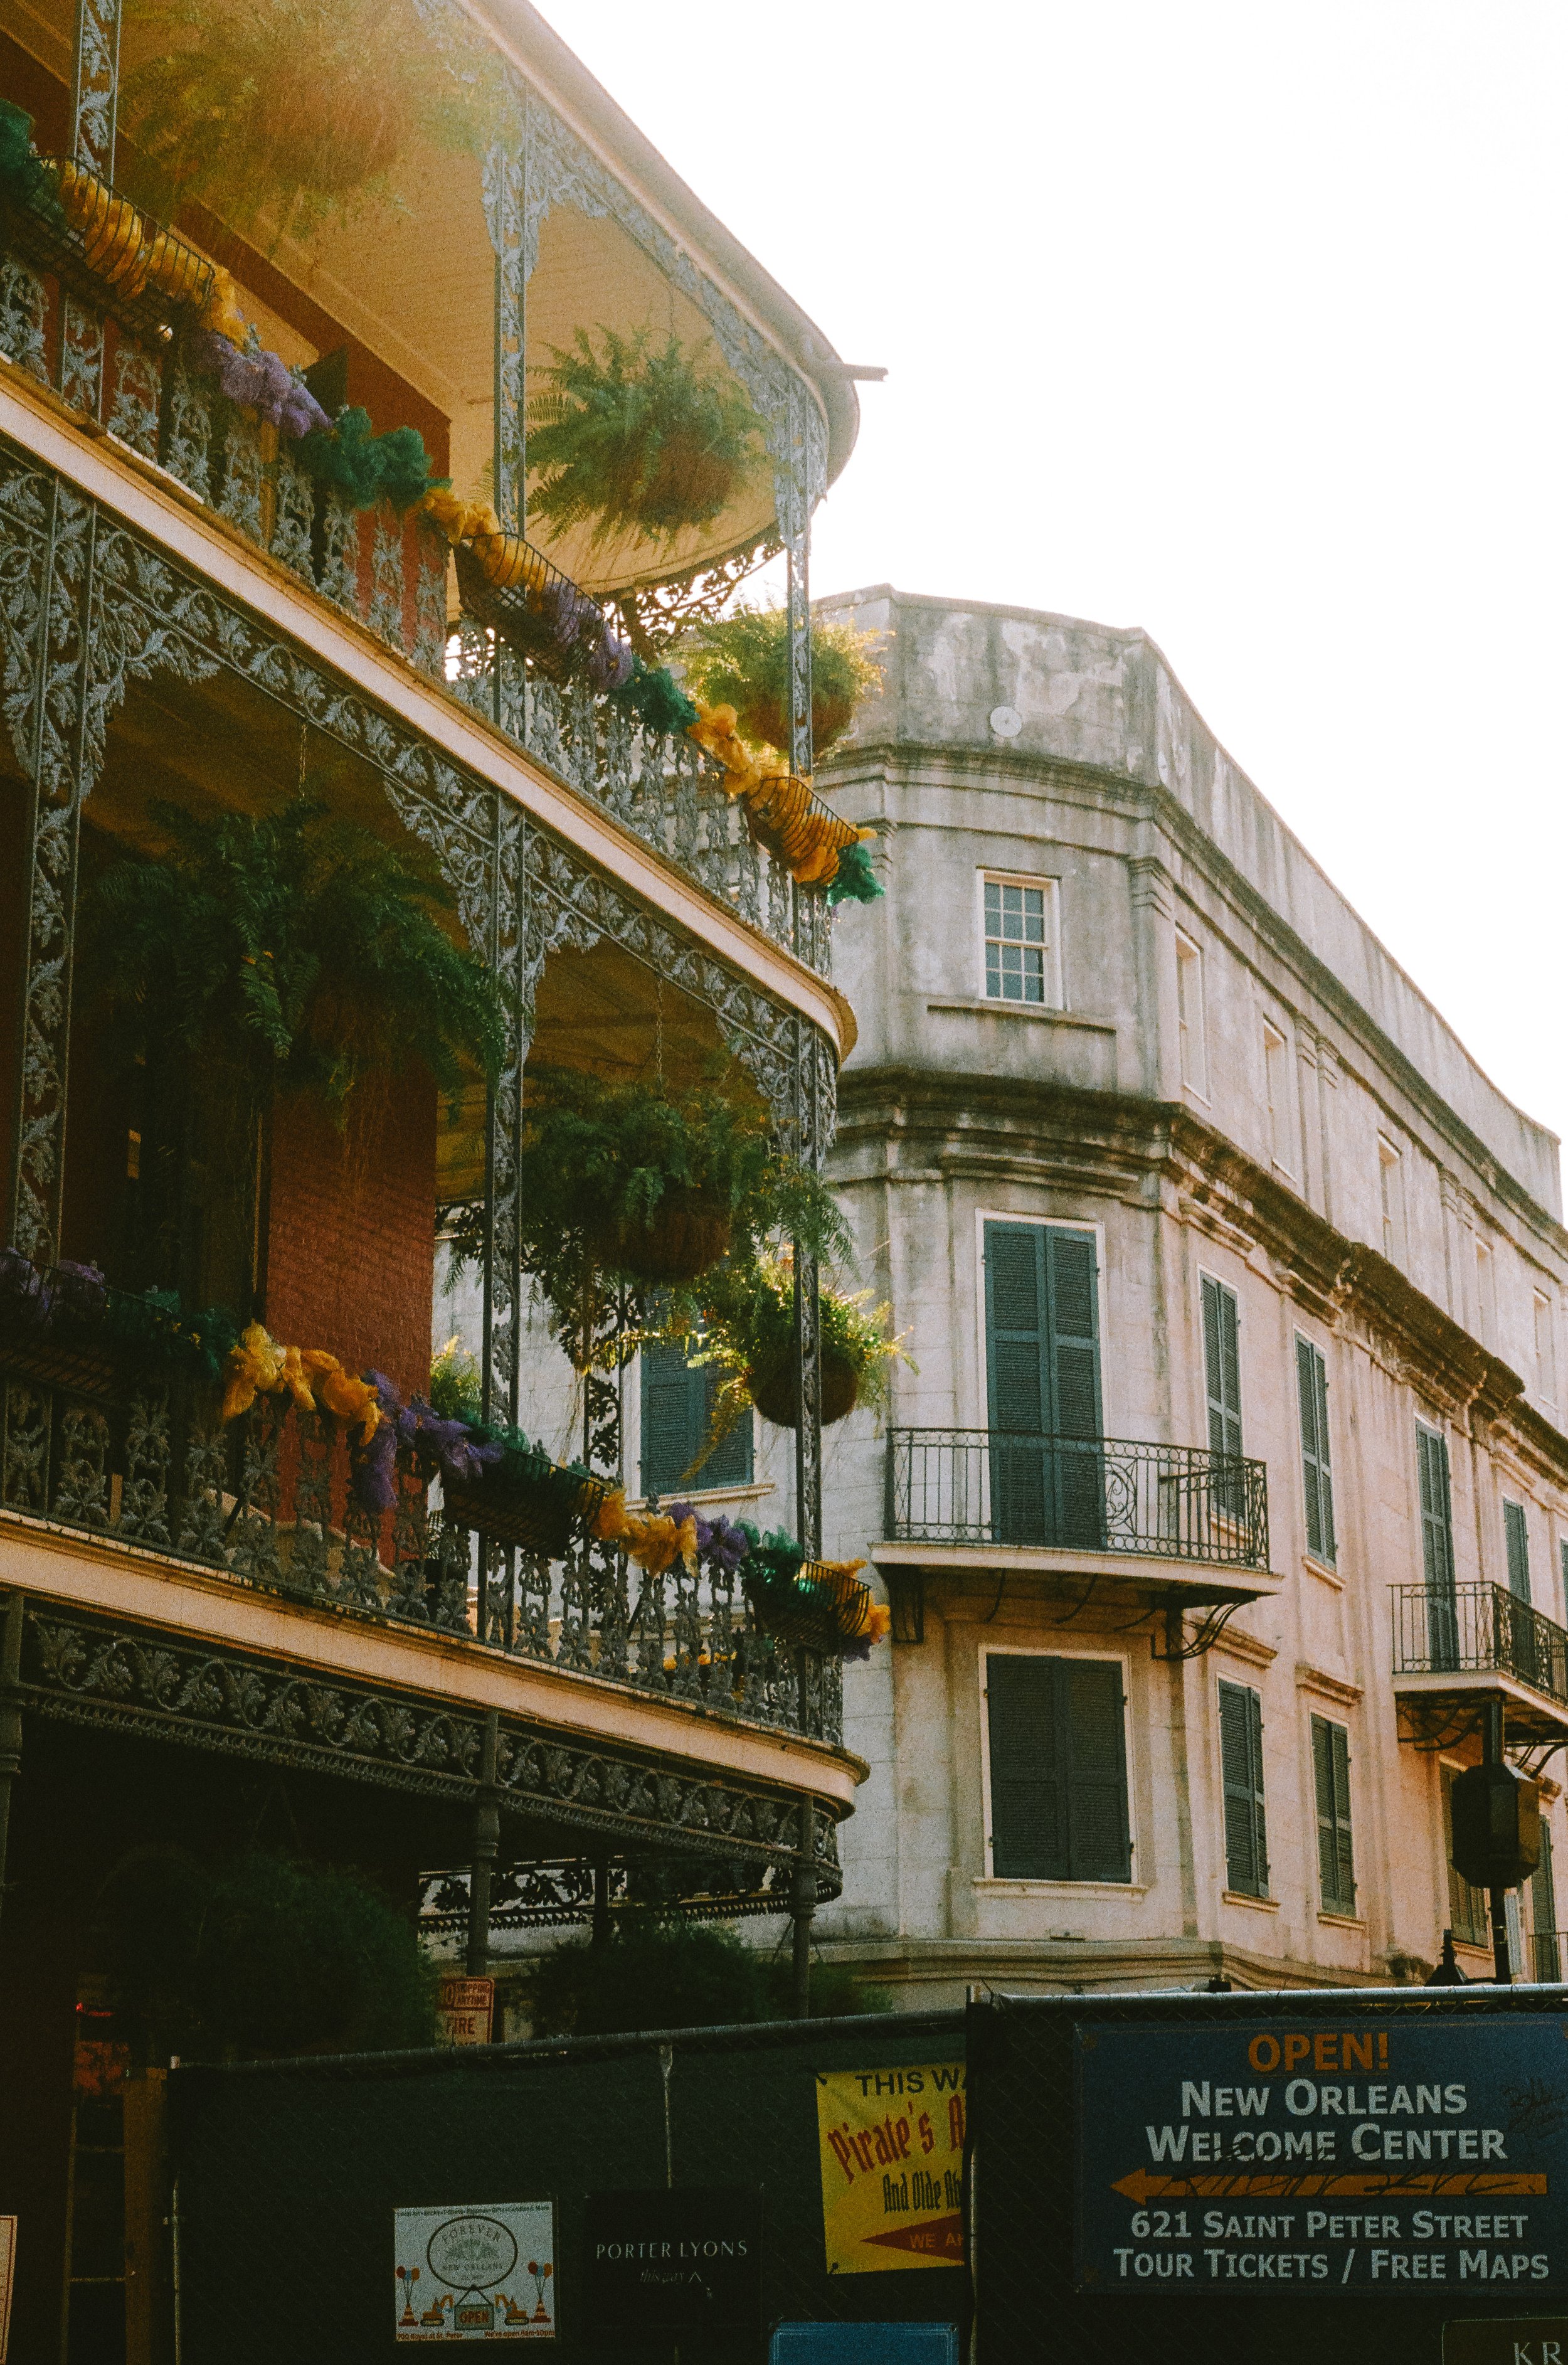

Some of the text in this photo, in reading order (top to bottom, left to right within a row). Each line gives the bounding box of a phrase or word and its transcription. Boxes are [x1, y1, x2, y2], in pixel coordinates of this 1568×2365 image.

[446, 2017, 475, 2035] FIRE
[1248, 2033, 1390, 2072] OPEN!
[855, 2068, 967, 2097] THIS W
[1182, 2081, 1269, 2117] NEW
[1285, 2078, 1468, 2117] ORLEANS
[827, 2102, 935, 2185] Pirate's
[1145, 2123, 1508, 2162] WELCOME CENTER
[882, 2172, 909, 2214] And
[912, 2171, 941, 2211] Olde
[442, 2224, 501, 2245] FOREVER
[1131, 2210, 1528, 2239] 621 SAINT PETER STREET
[596, 2240, 748, 2260] PORTER LYONS
[909, 2234, 935, 2249] WE
[442, 2263, 459, 2272] NEW
[640, 2268, 660, 2283] this
[1113, 2248, 1550, 2284] TOUR TICKETS / FREE MAPS
[458, 2310, 489, 2324] OPEN
